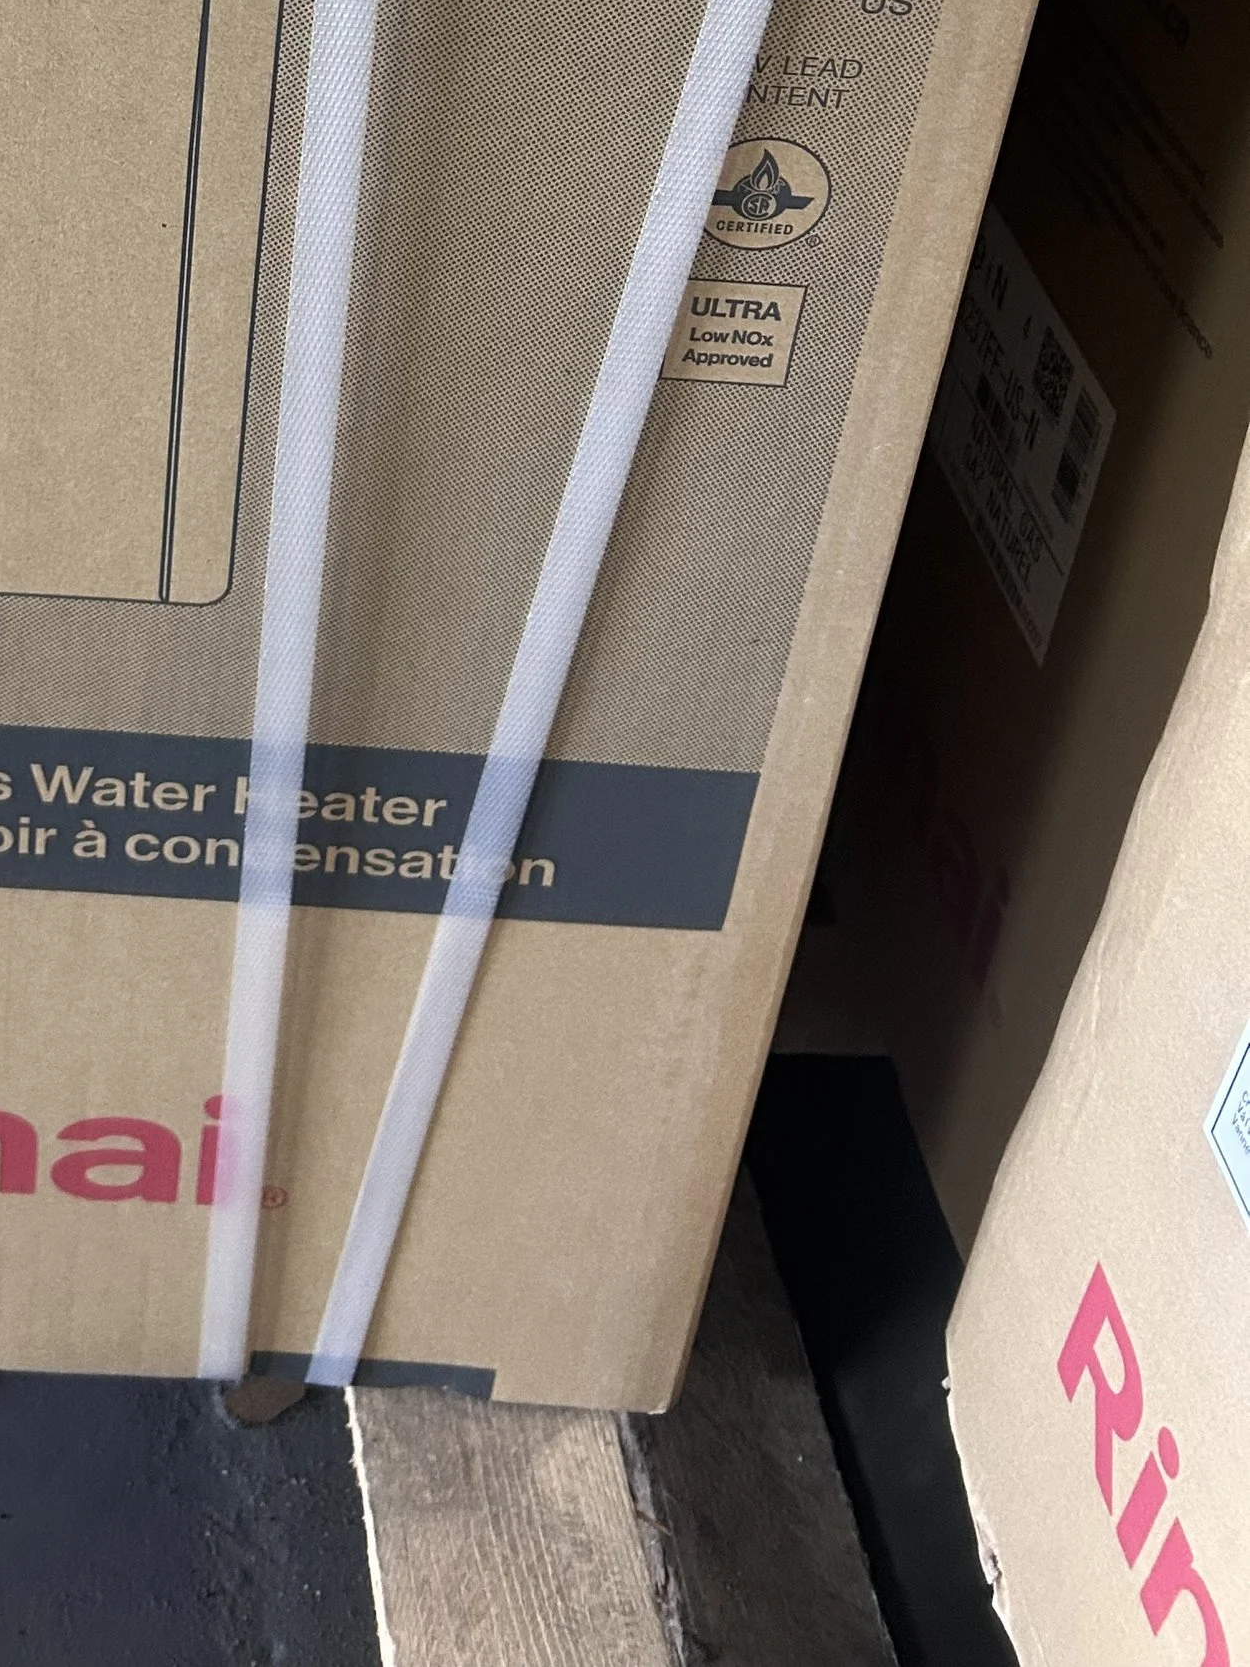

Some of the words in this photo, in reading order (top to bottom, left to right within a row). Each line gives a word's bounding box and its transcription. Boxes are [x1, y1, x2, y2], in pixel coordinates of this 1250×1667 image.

[783, 54, 864, 79] LEAD
[745, 83, 852, 110] NTENT
[715, 219, 795, 236] CERTIFIED
[690, 296, 782, 322] ULTRA
[689, 327, 729, 344] Low
[730, 330, 774, 347] NOx
[681, 348, 774, 368] Approved
[30, 763, 217, 814] Water
[73, 820, 107, 860] à
[124, 833, 557, 888] conensatn
